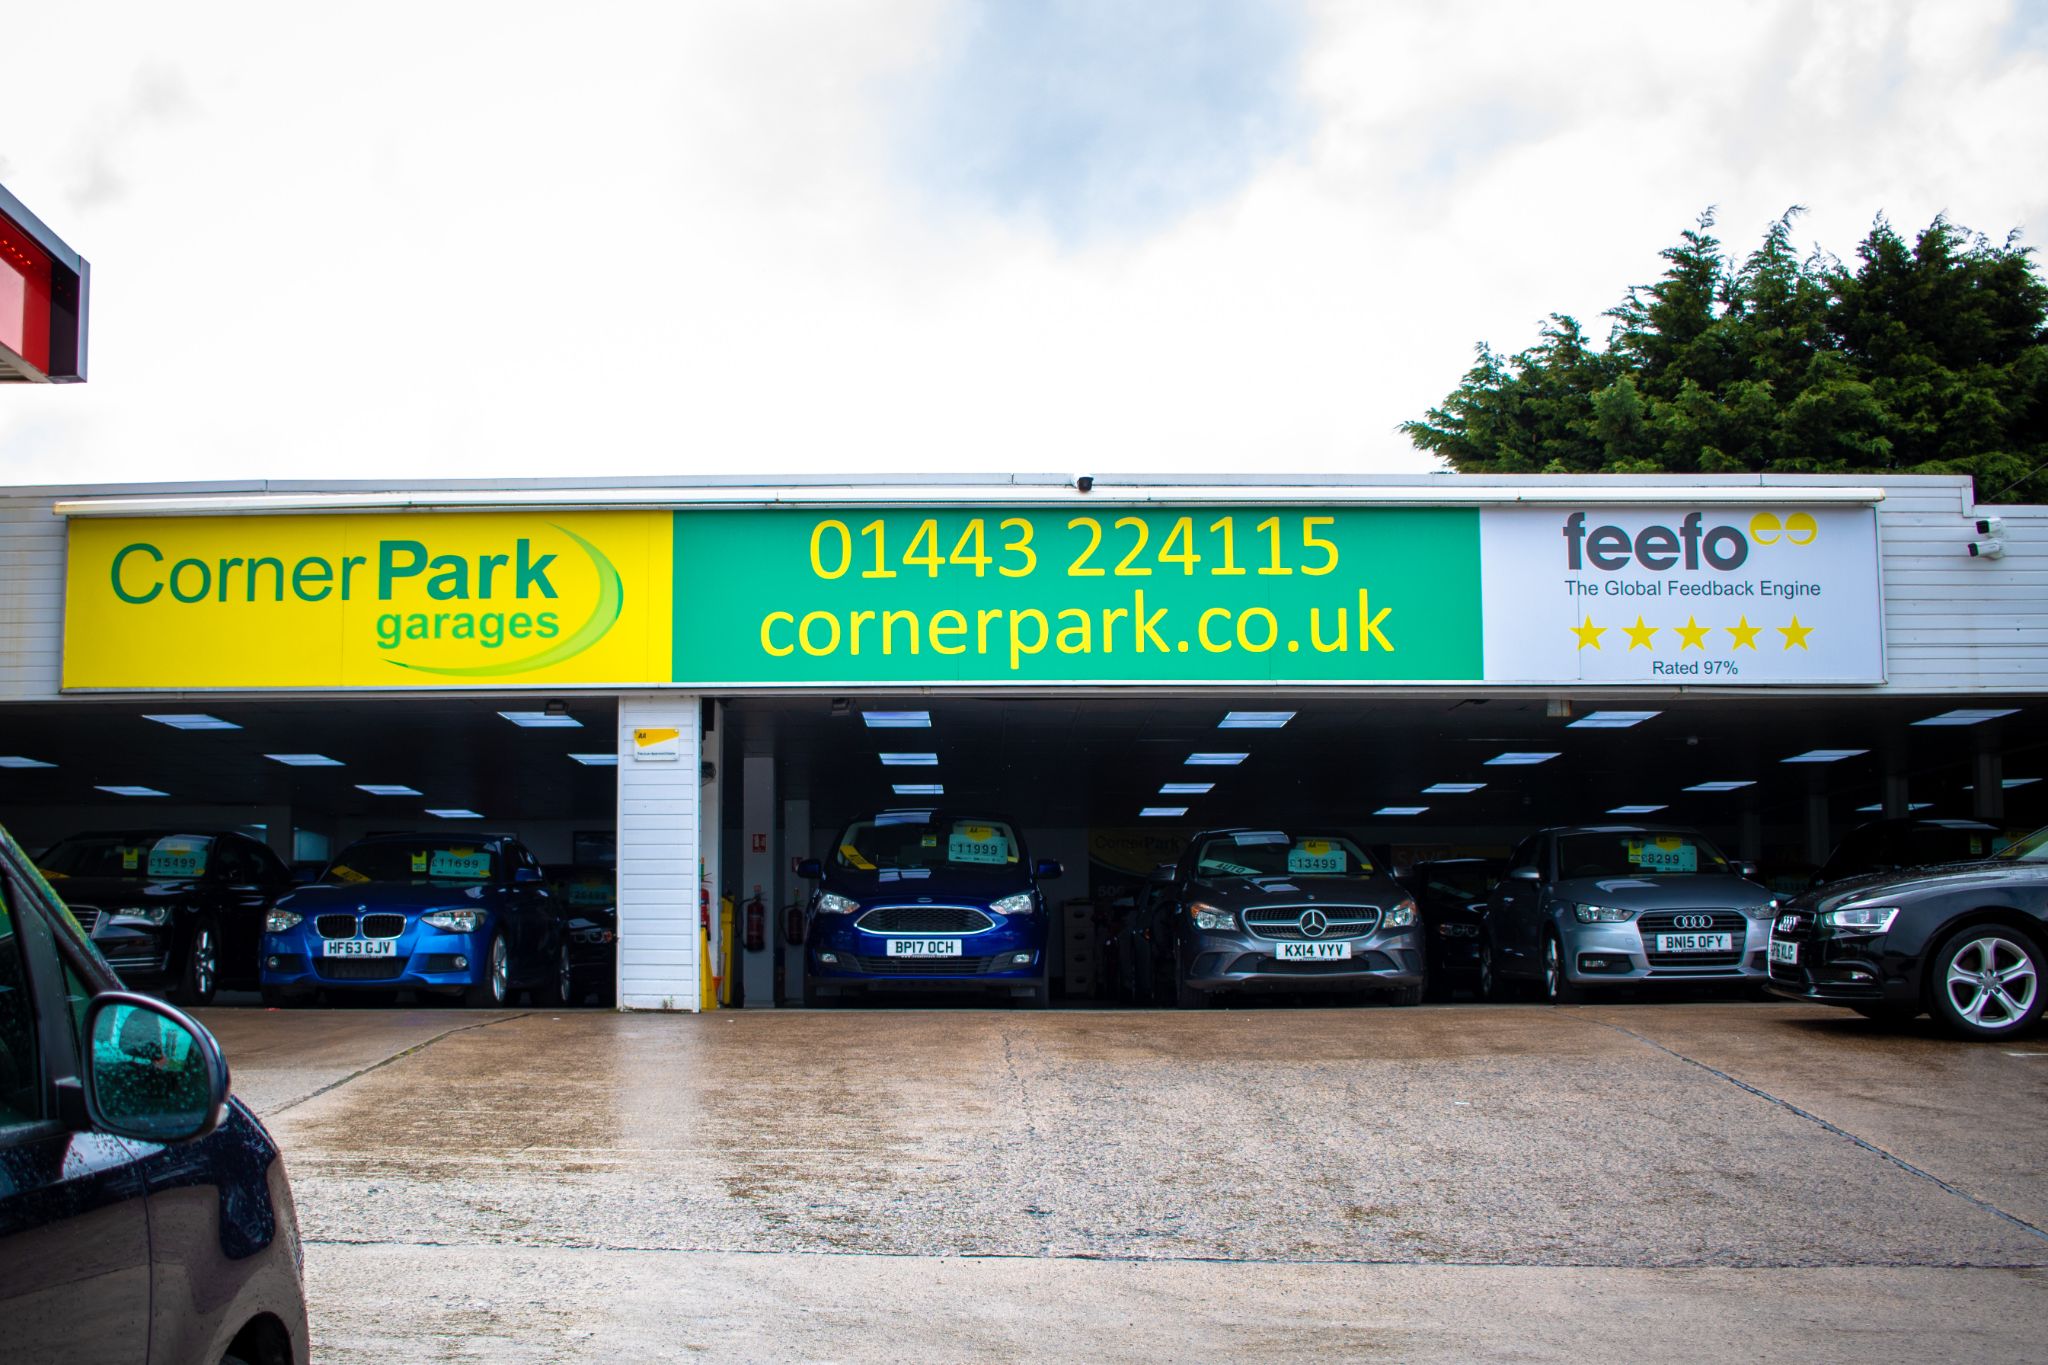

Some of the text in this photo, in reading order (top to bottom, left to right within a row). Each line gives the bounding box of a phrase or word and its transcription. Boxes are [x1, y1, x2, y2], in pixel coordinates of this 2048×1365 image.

[811, 516, 1339, 579] 01443 224115
[1562, 511, 1750, 572] feefo
[1564, 579, 1822, 600] The Global Feedback Engine
[376, 611, 560, 650] garages
[760, 588, 1395, 670] cornerpark.co.uk
[1652, 660, 1739, 676] Rated 97%
[328, 942, 391, 954] HF63 GJV
[895, 941, 954, 953] BP17 OCH
[1284, 943, 1343, 956] KX14 VYV
[1665, 935, 1723, 949] BN15 OFY
